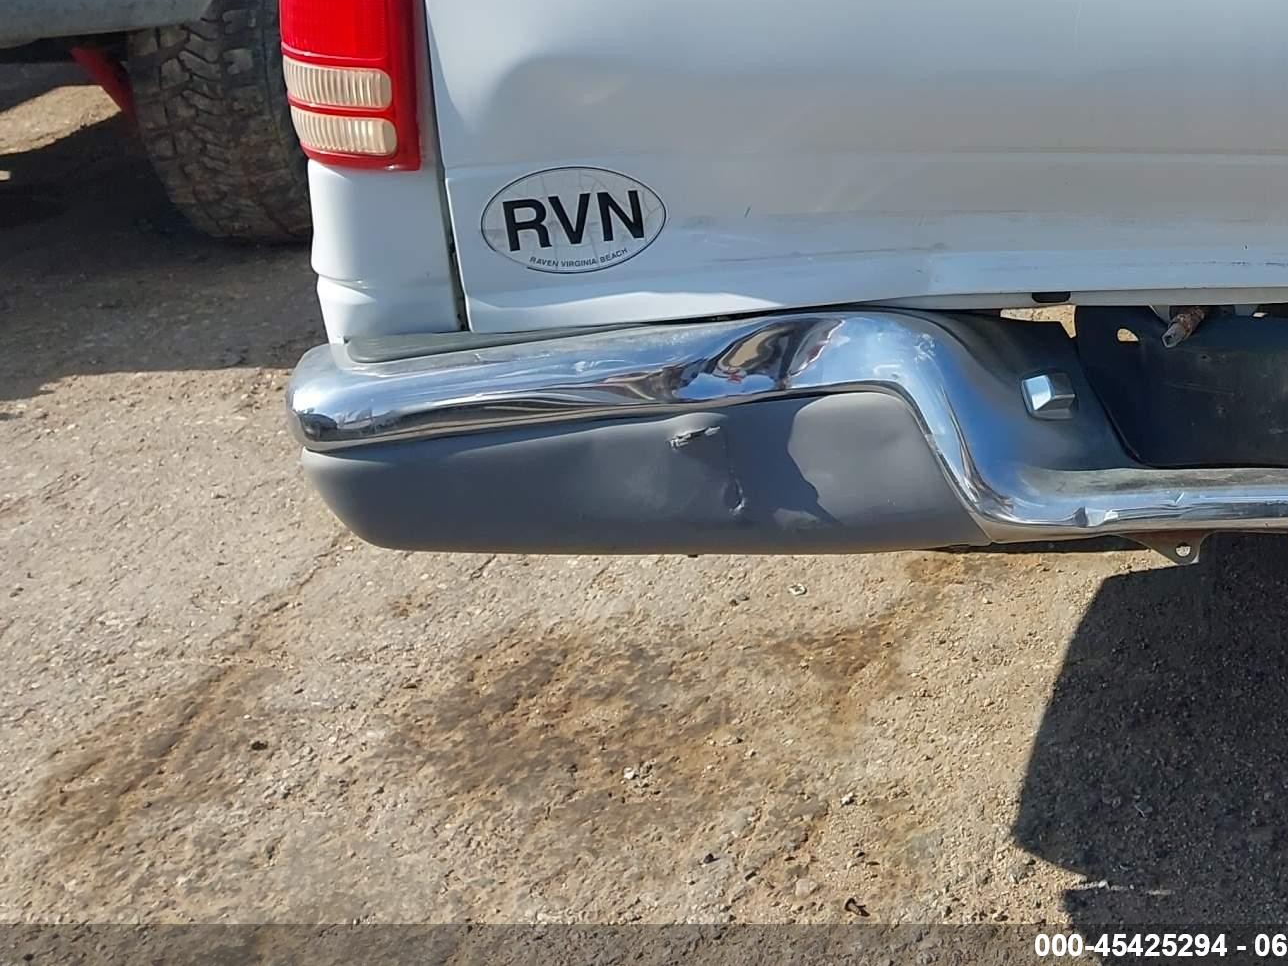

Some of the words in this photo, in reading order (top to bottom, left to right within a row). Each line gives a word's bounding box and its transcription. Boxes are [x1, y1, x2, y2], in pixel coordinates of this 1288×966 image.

[502, 189, 646, 252] RVN
[529, 255, 560, 268] RAVEN
[560, 257, 598, 268] VIRGINIA
[599, 247, 628, 265] BEACH
